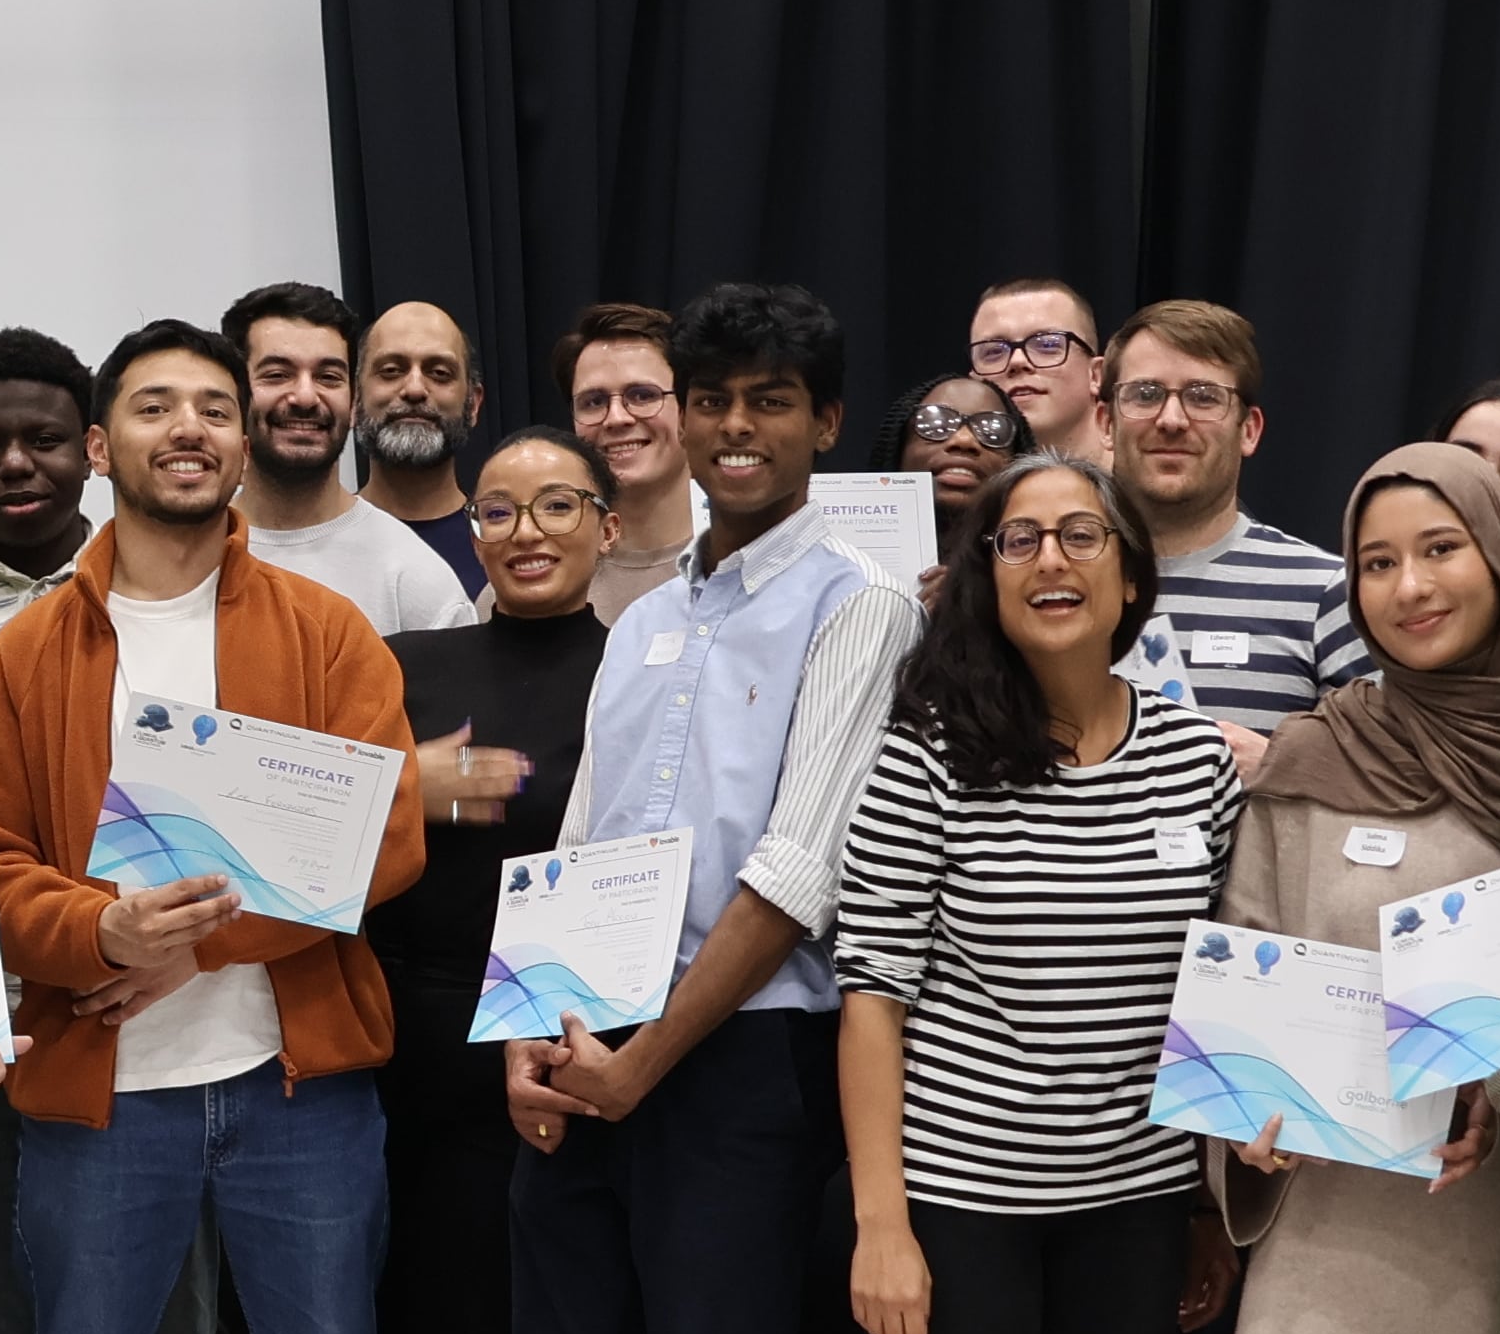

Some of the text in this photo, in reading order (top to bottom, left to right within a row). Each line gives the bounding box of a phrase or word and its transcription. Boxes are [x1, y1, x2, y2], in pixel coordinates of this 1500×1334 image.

[823, 505, 898, 515] ERTIFICATE
[258, 757, 355, 787] CERTIFICATE
[592, 869, 660, 890] CERTIFICATE
